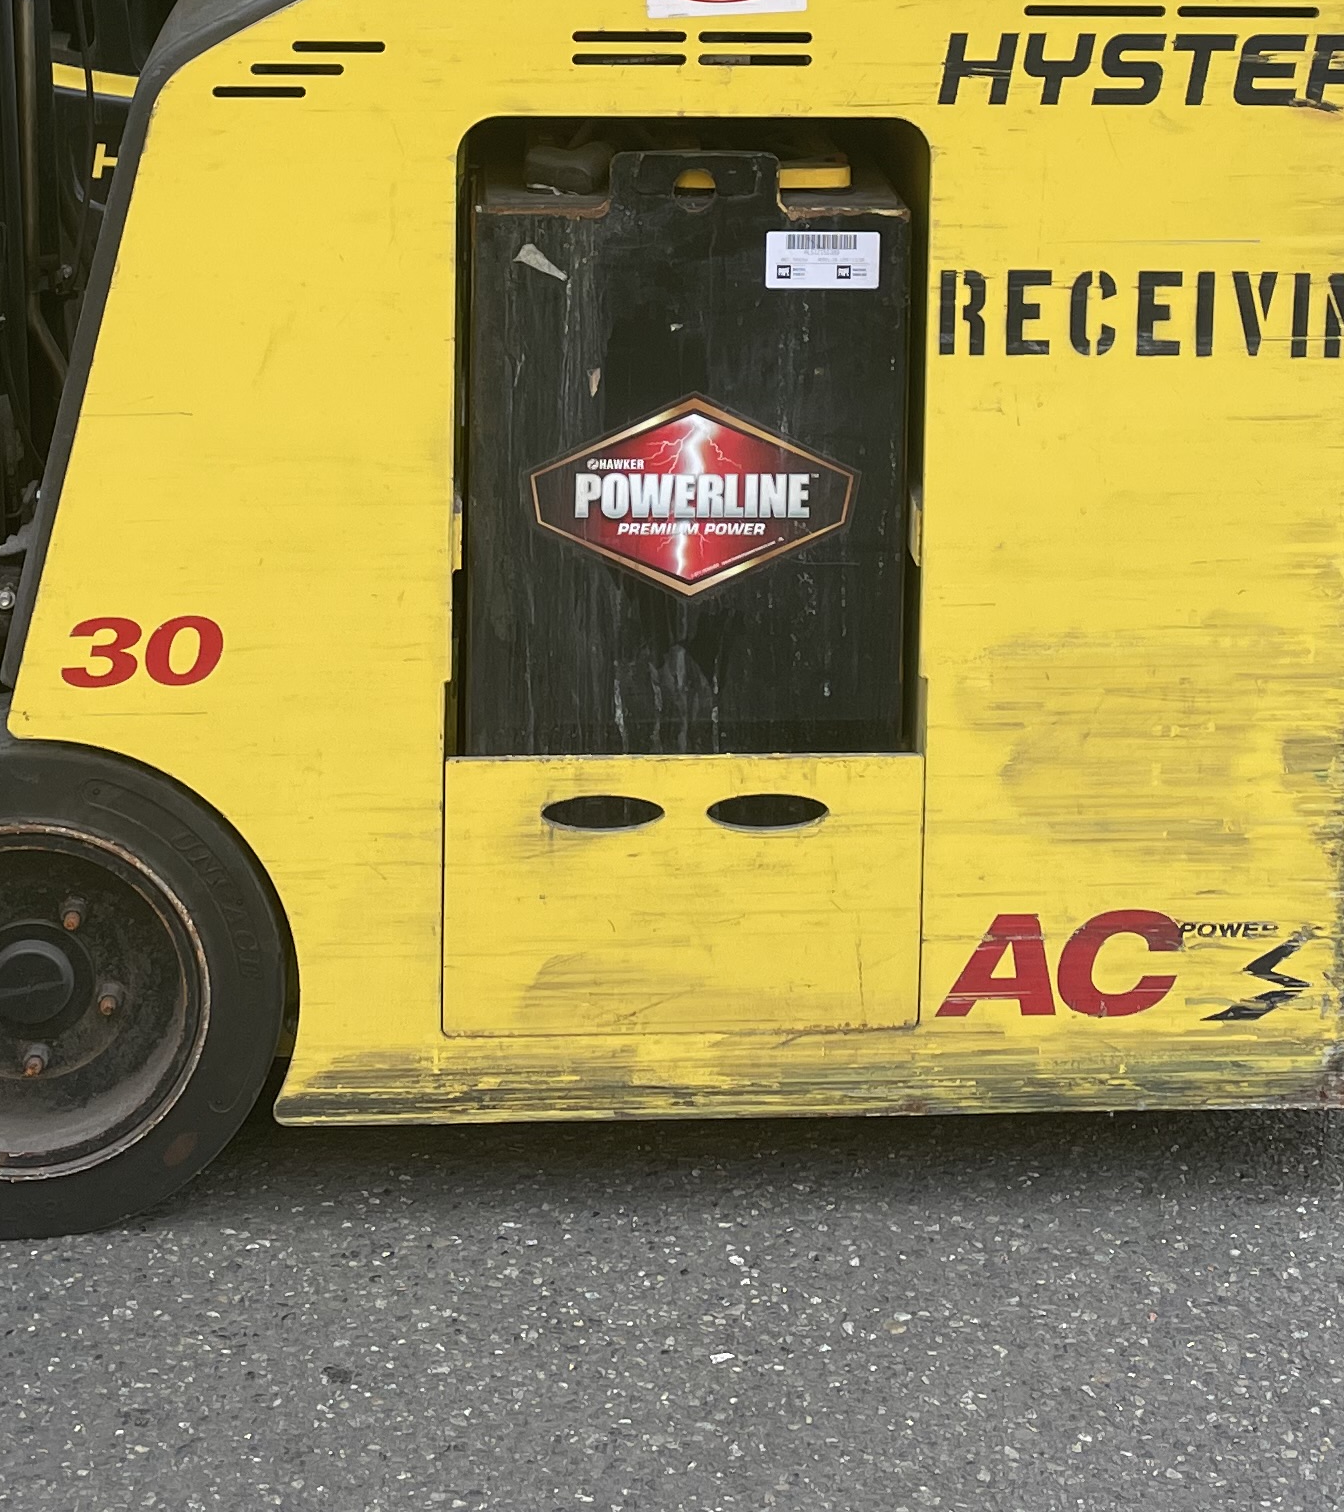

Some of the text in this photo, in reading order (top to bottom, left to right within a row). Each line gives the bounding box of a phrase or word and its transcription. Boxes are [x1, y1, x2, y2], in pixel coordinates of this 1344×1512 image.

[599, 458, 644, 471] HAWKER
[574, 472, 811, 519] POWERLINE
[617, 522, 766, 536] PREMIUM POWER
[61, 615, 224, 688] 30
[935, 909, 1185, 1018] AC
